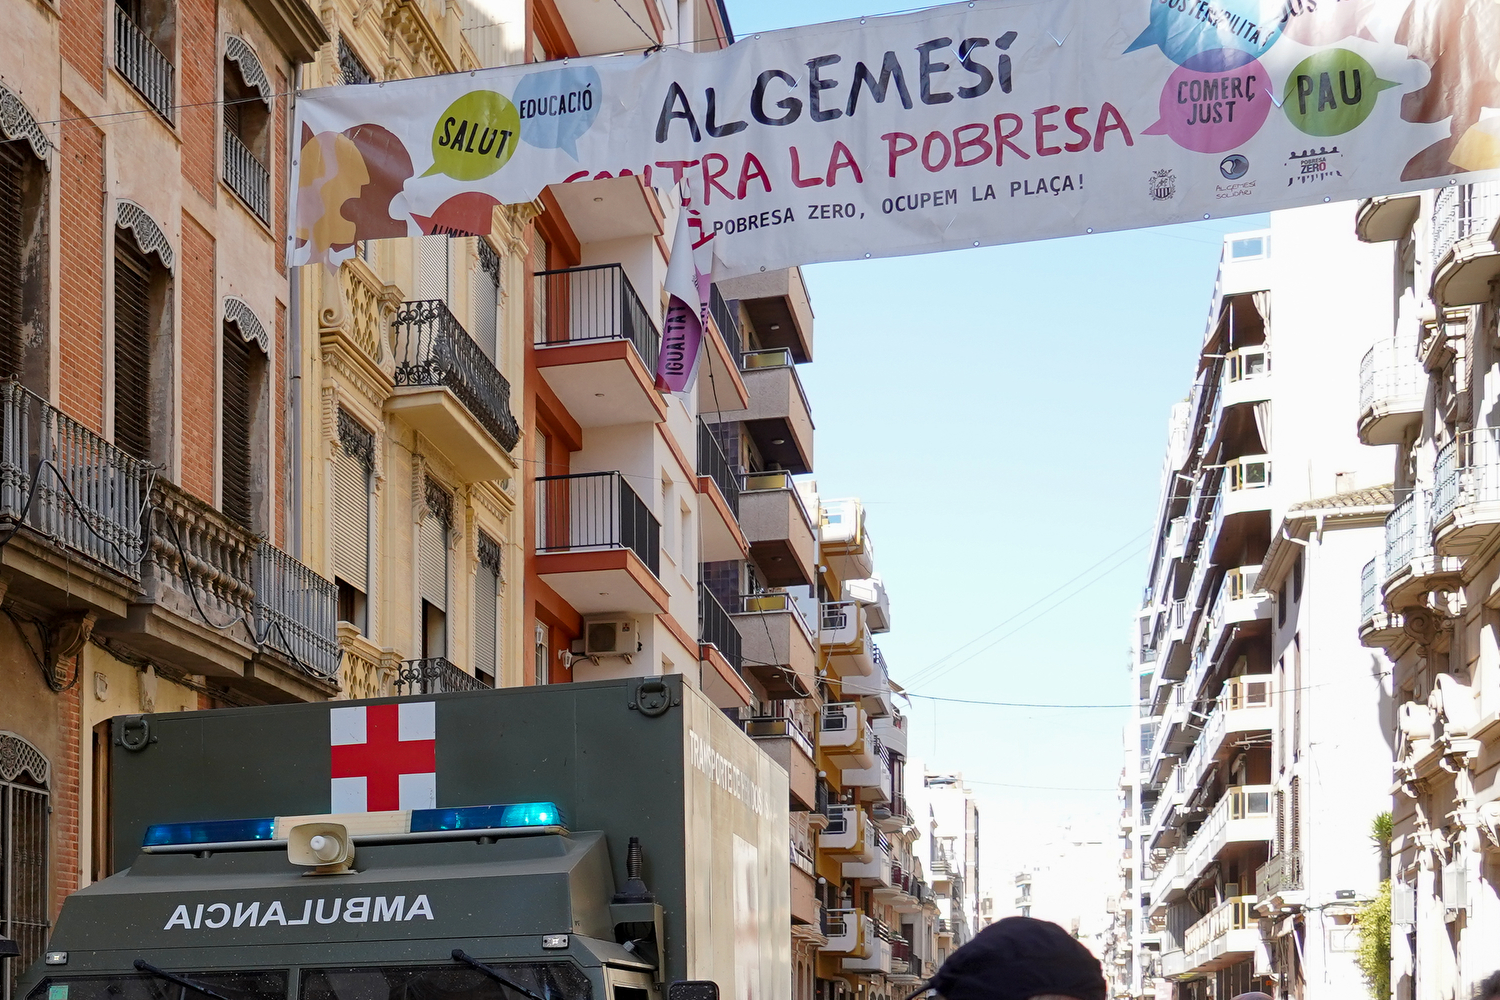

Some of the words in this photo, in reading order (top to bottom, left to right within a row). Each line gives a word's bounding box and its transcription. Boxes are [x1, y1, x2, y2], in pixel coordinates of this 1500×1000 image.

[520, 83, 593, 119] EDUCACIÓ
[655, 31, 1018, 143] ALGEMESÍ
[1177, 76, 1256, 104] COMERÇ
[1296, 69, 1362, 115] PAU
[1186, 101, 1236, 125] JUST
[438, 116, 512, 159] SALUT
[563, 152, 772, 206] TRA
[789, 140, 864, 188] LA
[881, 102, 1134, 178] POBRESA
[1300, 157, 1327, 166] POBRESA
[1300, 162, 1327, 175] ZERO
[713, 206, 795, 236] POBRESA
[808, 202, 866, 221] ZERO,
[882, 189, 958, 214] OCUPEM
[972, 184, 996, 203] LA
[1010, 174, 1085, 198] PLAÇA!
